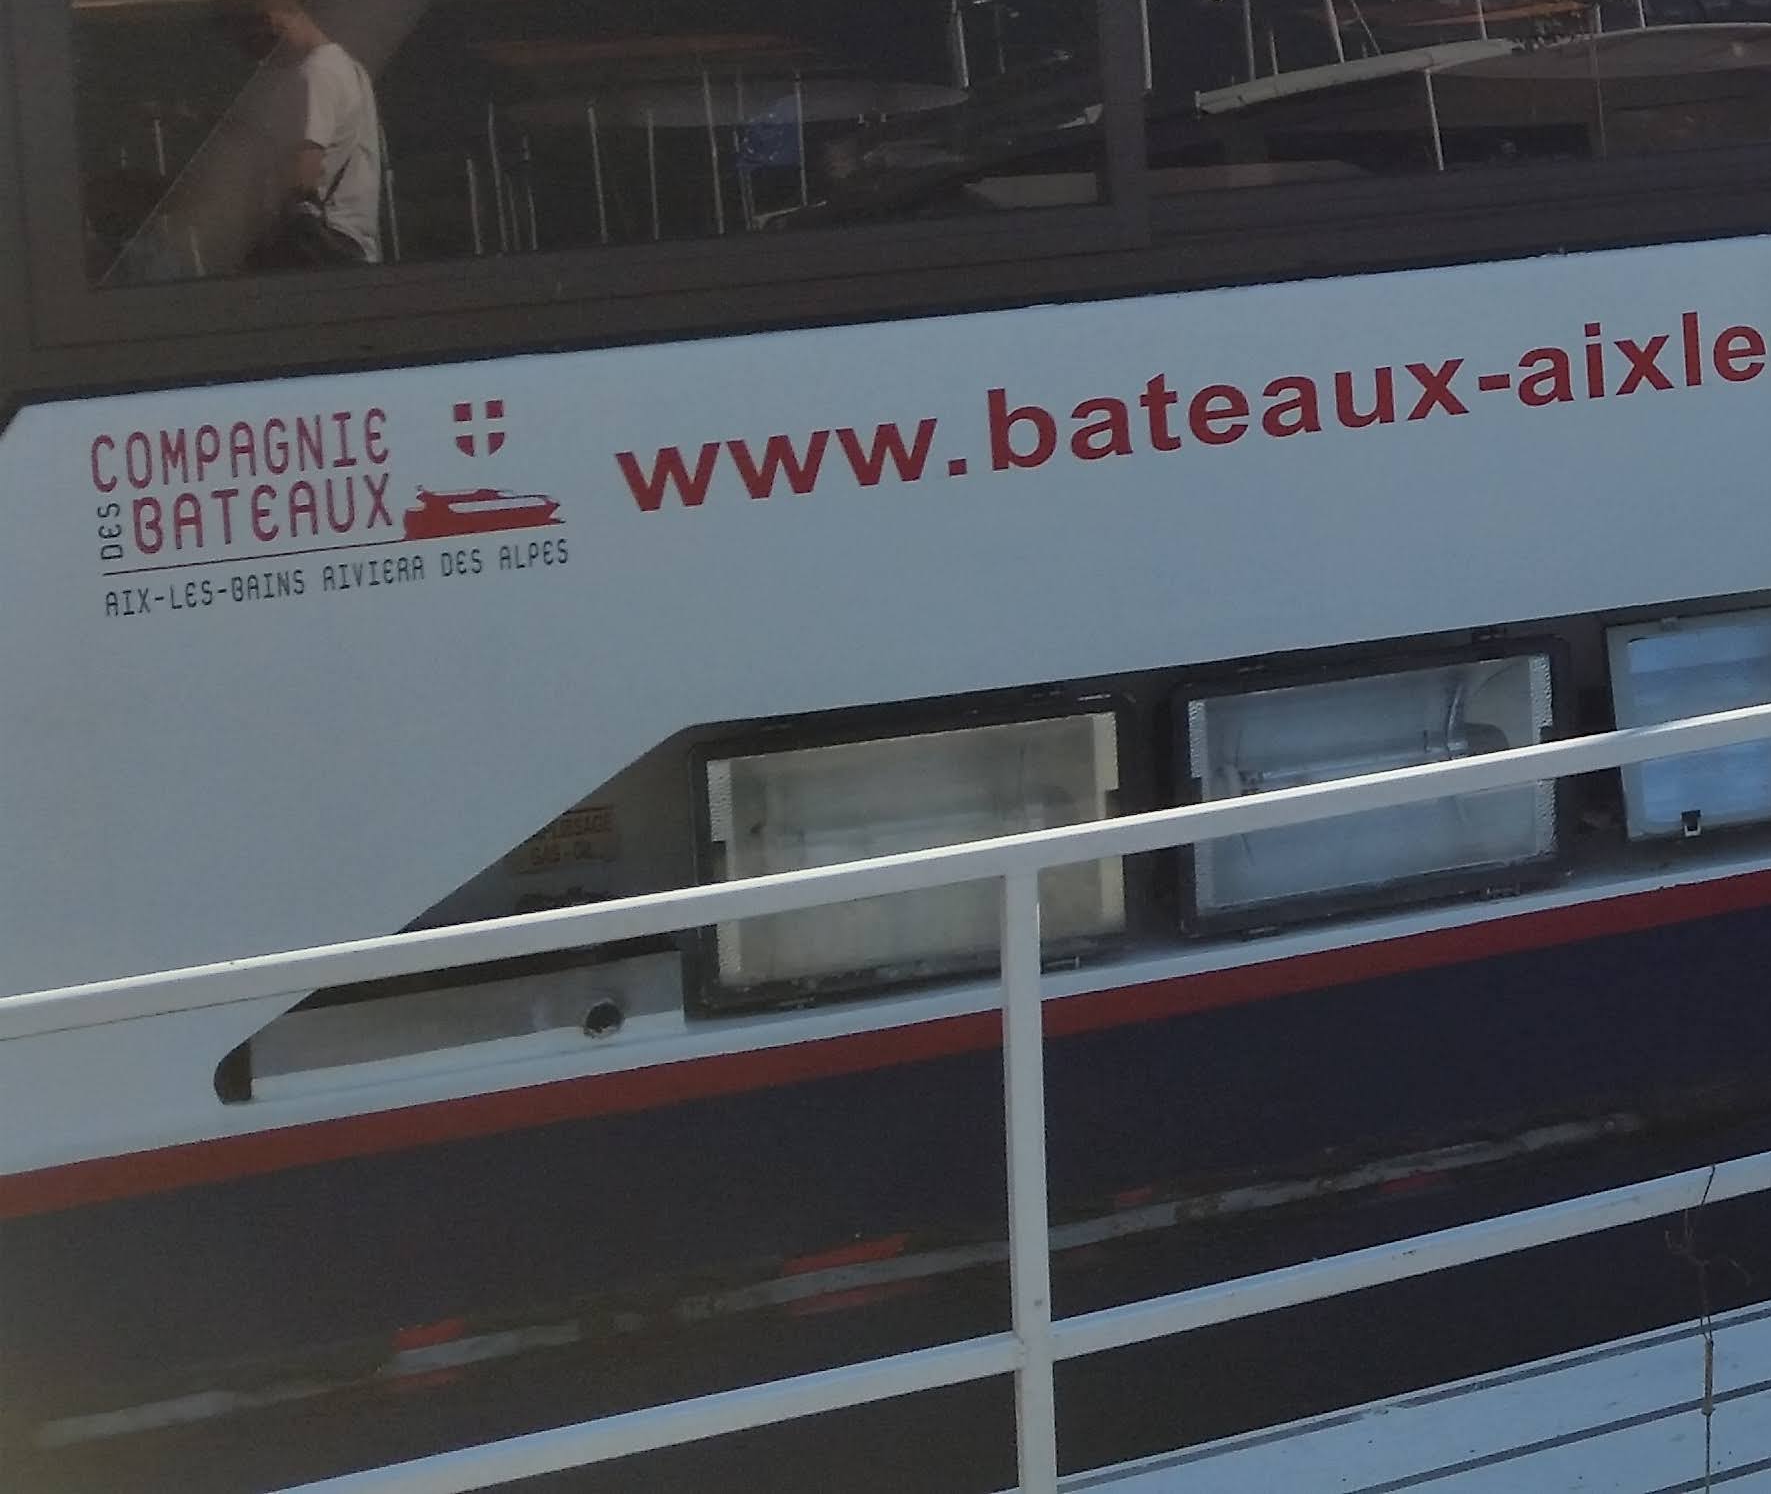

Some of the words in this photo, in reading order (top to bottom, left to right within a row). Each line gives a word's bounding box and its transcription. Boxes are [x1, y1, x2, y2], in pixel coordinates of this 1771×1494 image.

[91, 407, 390, 494] COMPAGNIE
[98, 502, 125, 561] DES
[133, 472, 394, 554] BATEAUX
[104, 569, 306, 618] AIX-LES-BAINS
[441, 548, 484, 578] DES
[499, 539, 570, 570] ALPES
